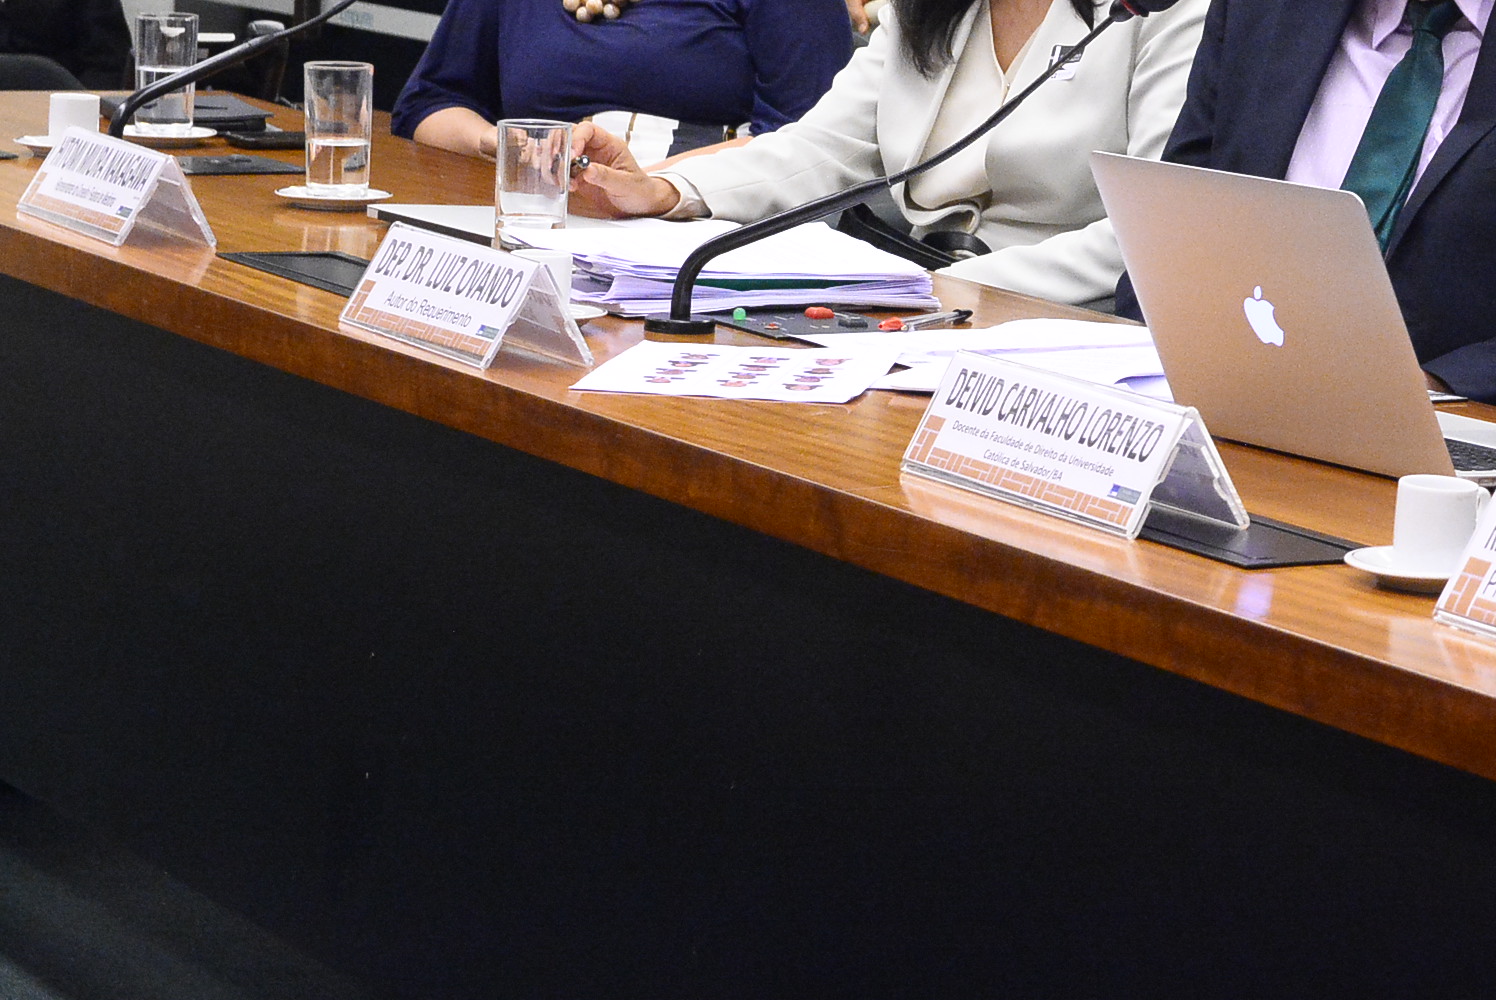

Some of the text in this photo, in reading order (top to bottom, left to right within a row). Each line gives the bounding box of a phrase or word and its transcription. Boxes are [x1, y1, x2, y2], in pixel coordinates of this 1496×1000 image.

[374, 239, 524, 308] DEP. DR. LUIZ OVANDO
[384, 291, 472, 328] Autor do Requerimento
[945, 368, 1165, 463] DEIVID CARVALHO LORENZO
[952, 419, 1115, 477] Docente da Faculdade de Direito da Universidade
[1010, 456, 1021, 469] de
[1019, 459, 1064, 482] Salvador/BA
